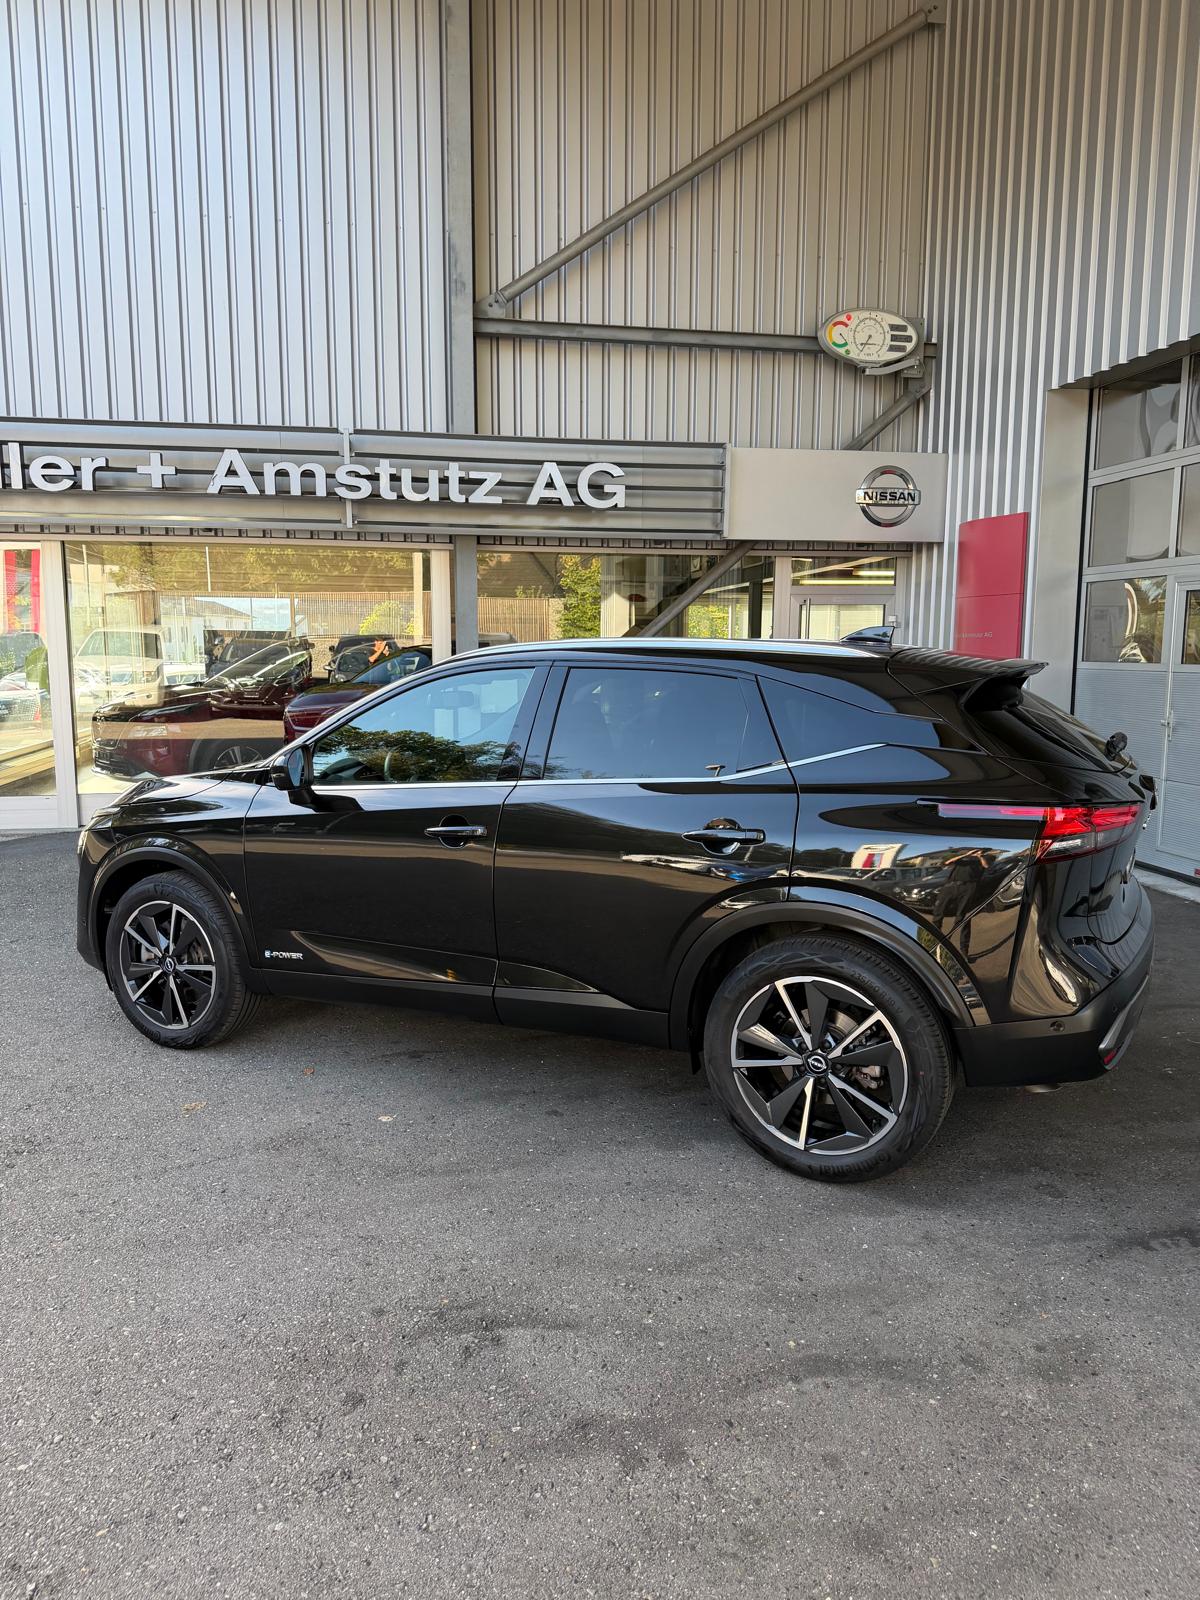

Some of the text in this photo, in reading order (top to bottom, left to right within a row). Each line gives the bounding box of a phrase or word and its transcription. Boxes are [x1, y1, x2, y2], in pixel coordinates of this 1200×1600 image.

[0, 441, 107, 492] ler
[207, 448, 503, 505] Amstutz
[526, 461, 627, 509] AG
[863, 491, 916, 502] NISSAN
